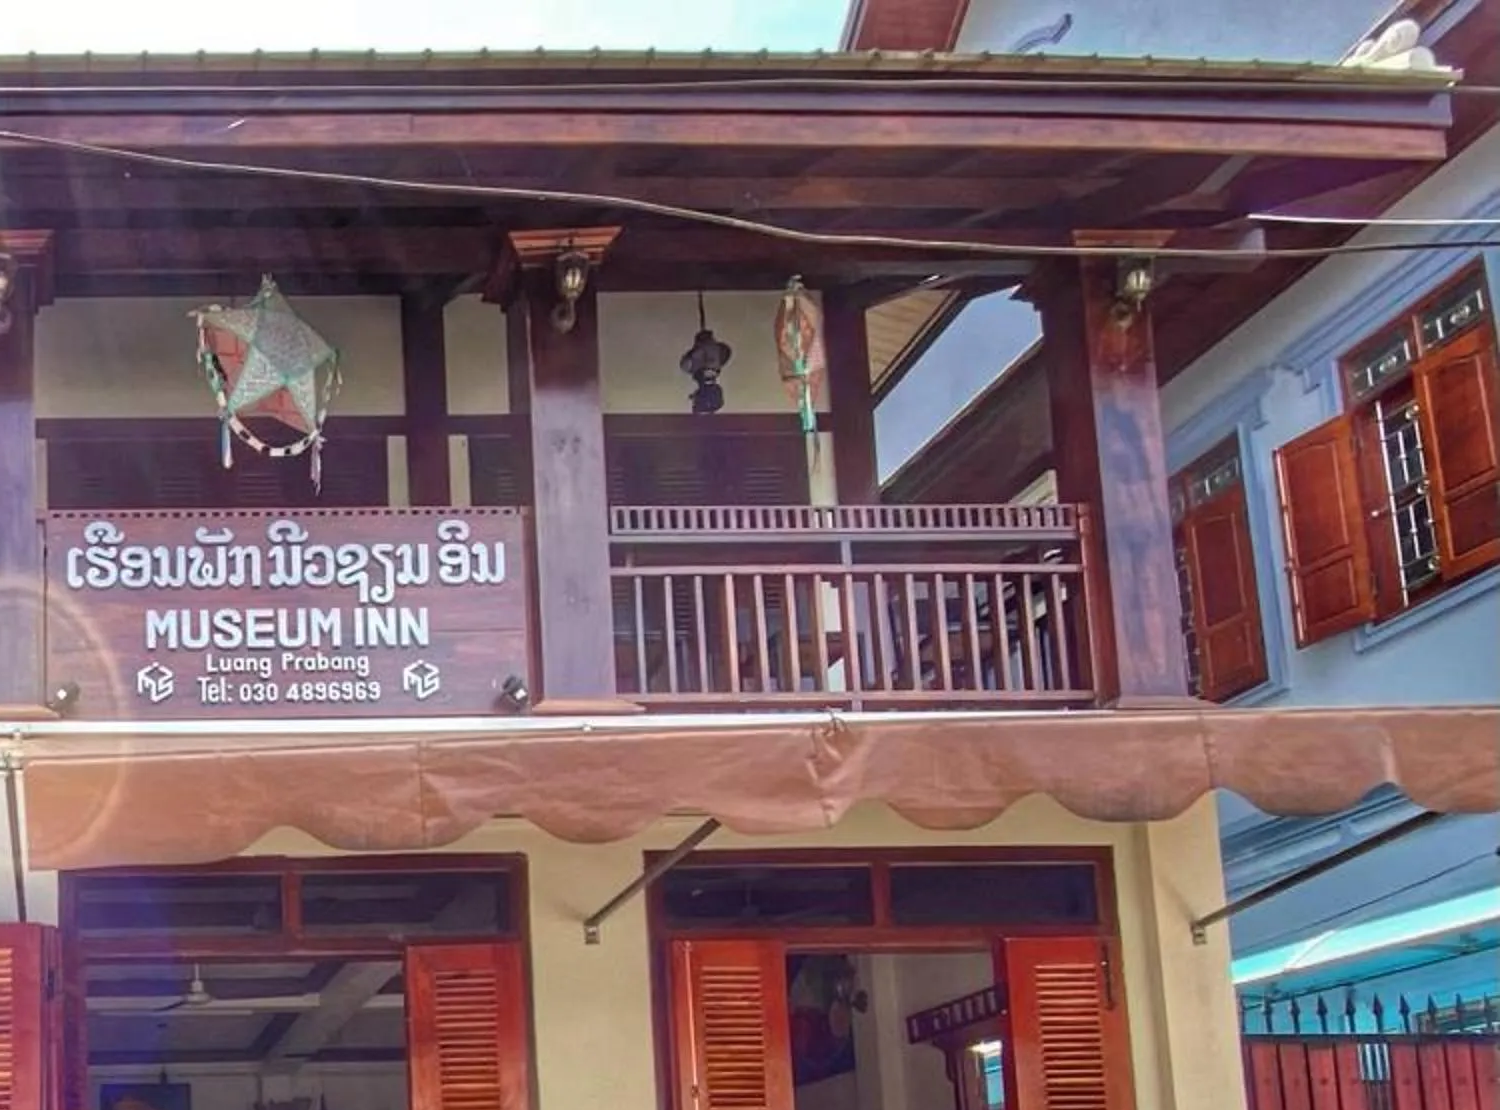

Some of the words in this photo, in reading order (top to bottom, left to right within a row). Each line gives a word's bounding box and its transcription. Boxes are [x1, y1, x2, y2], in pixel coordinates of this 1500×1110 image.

[146, 607, 342, 650] MUSEUM
[354, 606, 430, 648] INN
[205, 653, 272, 678] Luang
[281, 651, 370, 676] Prabang
[197, 677, 233, 702] Tel:
[239, 683, 278, 702] 030
[285, 681, 381, 702] 4896969
